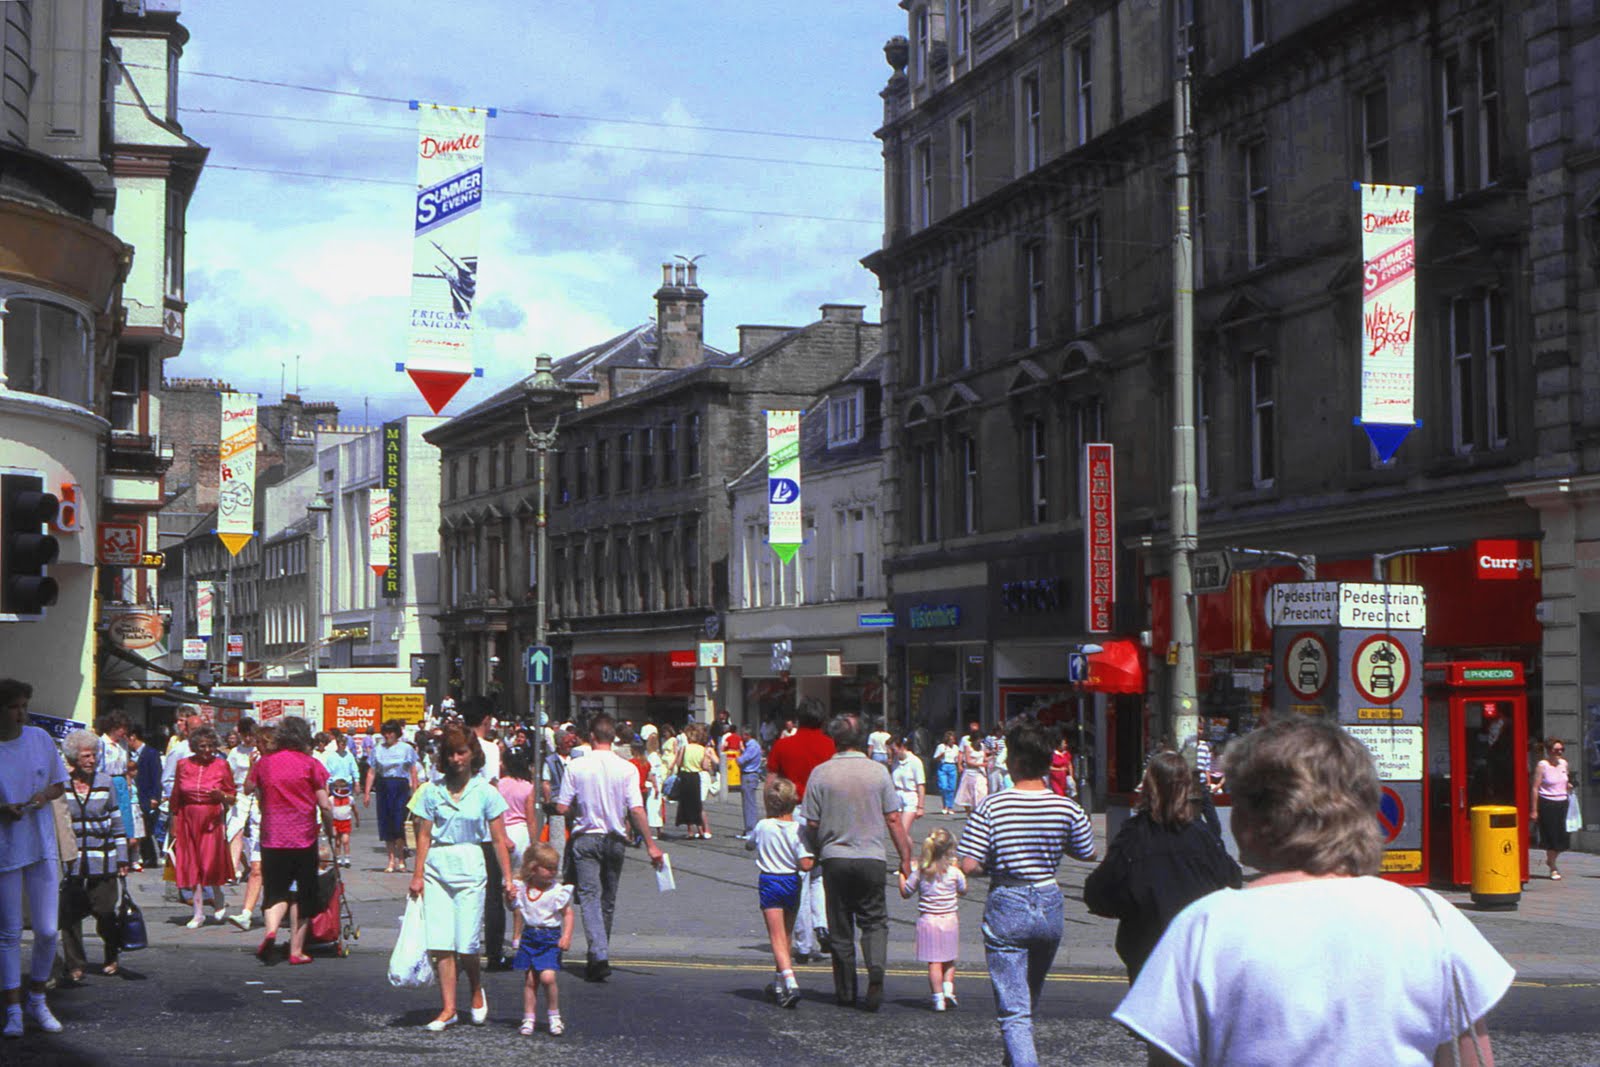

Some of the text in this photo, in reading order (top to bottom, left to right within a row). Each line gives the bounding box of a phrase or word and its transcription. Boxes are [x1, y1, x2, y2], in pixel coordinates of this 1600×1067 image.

[420, 133, 480, 159] Dundee
[418, 172, 481, 223] SUMMER
[441, 189, 480, 213] EVENTS
[1363, 208, 1411, 233] Dundee
[1364, 244, 1413, 291] SUMMER
[410, 319, 472, 330] UNICORN
[386, 428, 399, 488] MARKS
[387, 507, 398, 592] SPENCER
[1092, 461, 1111, 629] AMUSEMENTS
[1479, 555, 1533, 571] Currys
[1276, 588, 1338, 603] Pedestrian
[1343, 589, 1419, 605] Pedestrian
[1283, 606, 1332, 620] Precinct
[1352, 607, 1411, 623] Precinct
[602, 667, 641, 683] Dixons
[336, 706, 375, 717] Balfour
[1371, 710, 1380, 718] all
[336, 717, 373, 728] Beatty
[1347, 727, 1413, 736] Except for goods
[1379, 761, 1410, 771] Midnight
